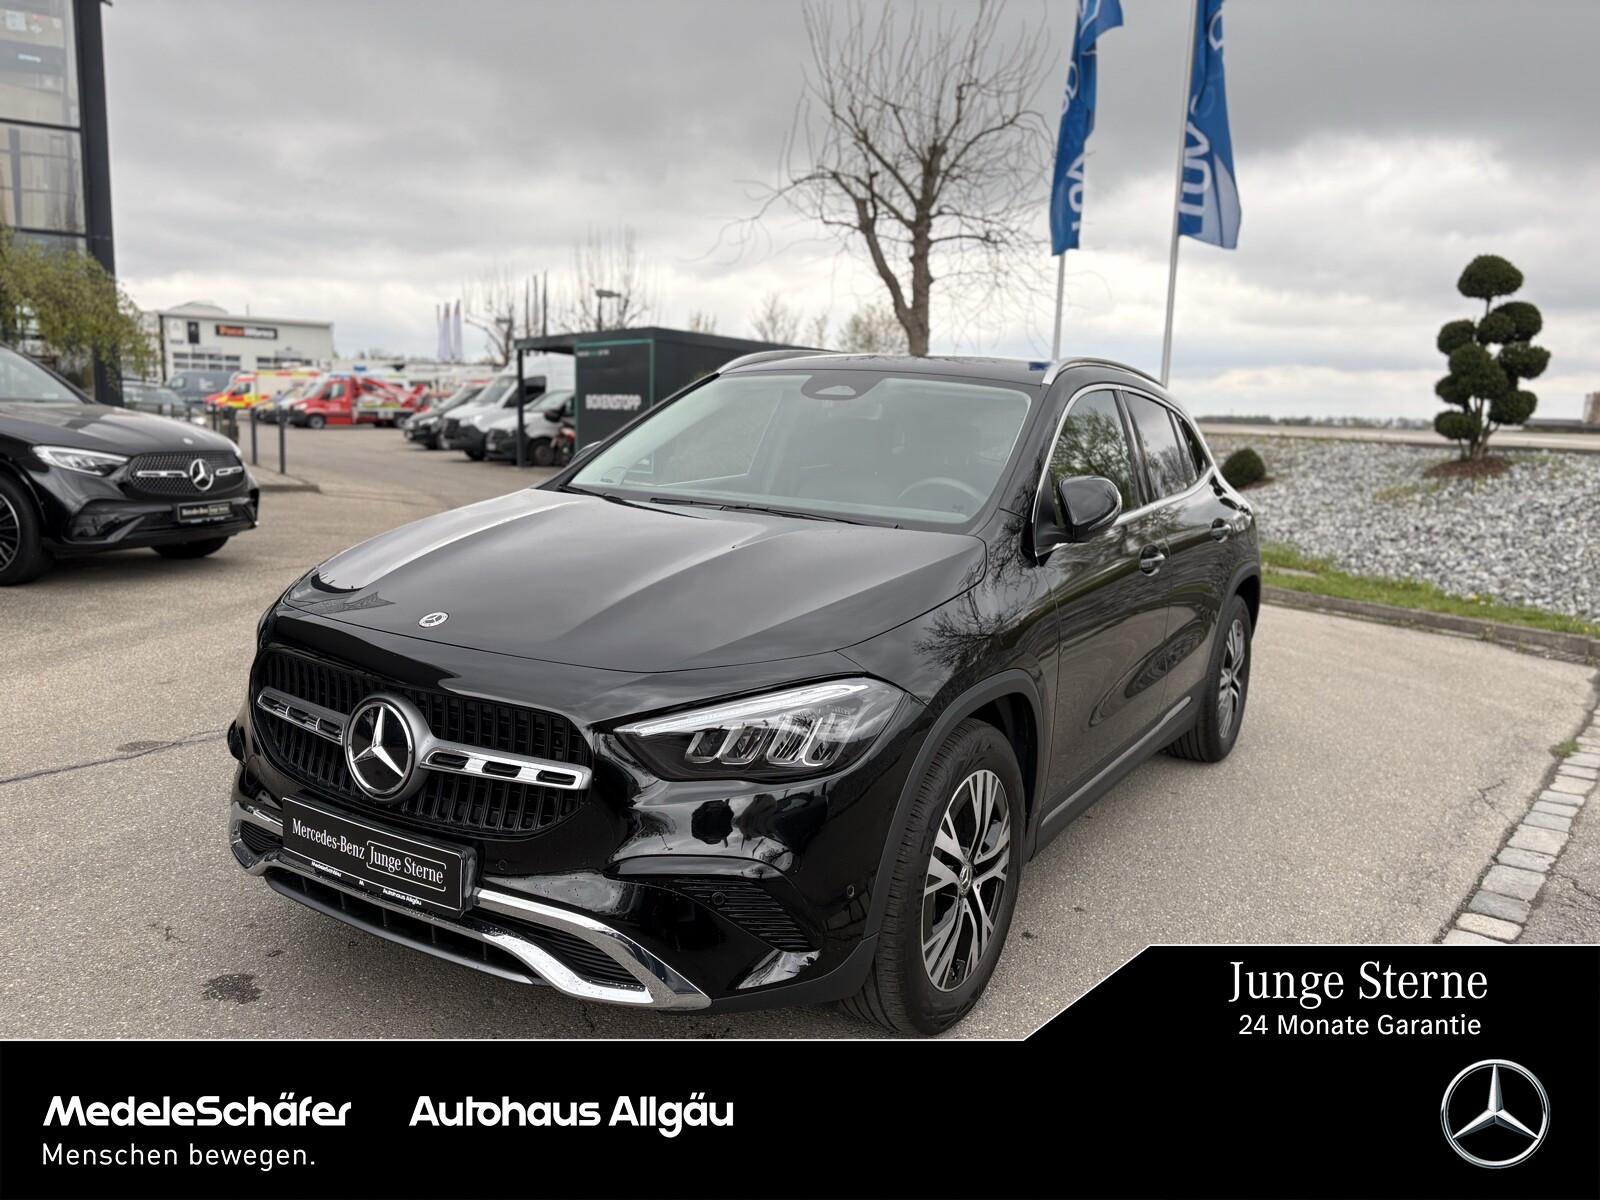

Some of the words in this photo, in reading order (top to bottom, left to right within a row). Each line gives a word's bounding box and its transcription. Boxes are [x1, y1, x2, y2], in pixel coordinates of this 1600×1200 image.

[292, 818, 365, 860] Mercedes-Benz
[369, 846, 402, 873] Junge
[404, 856, 444, 884] Sterne
